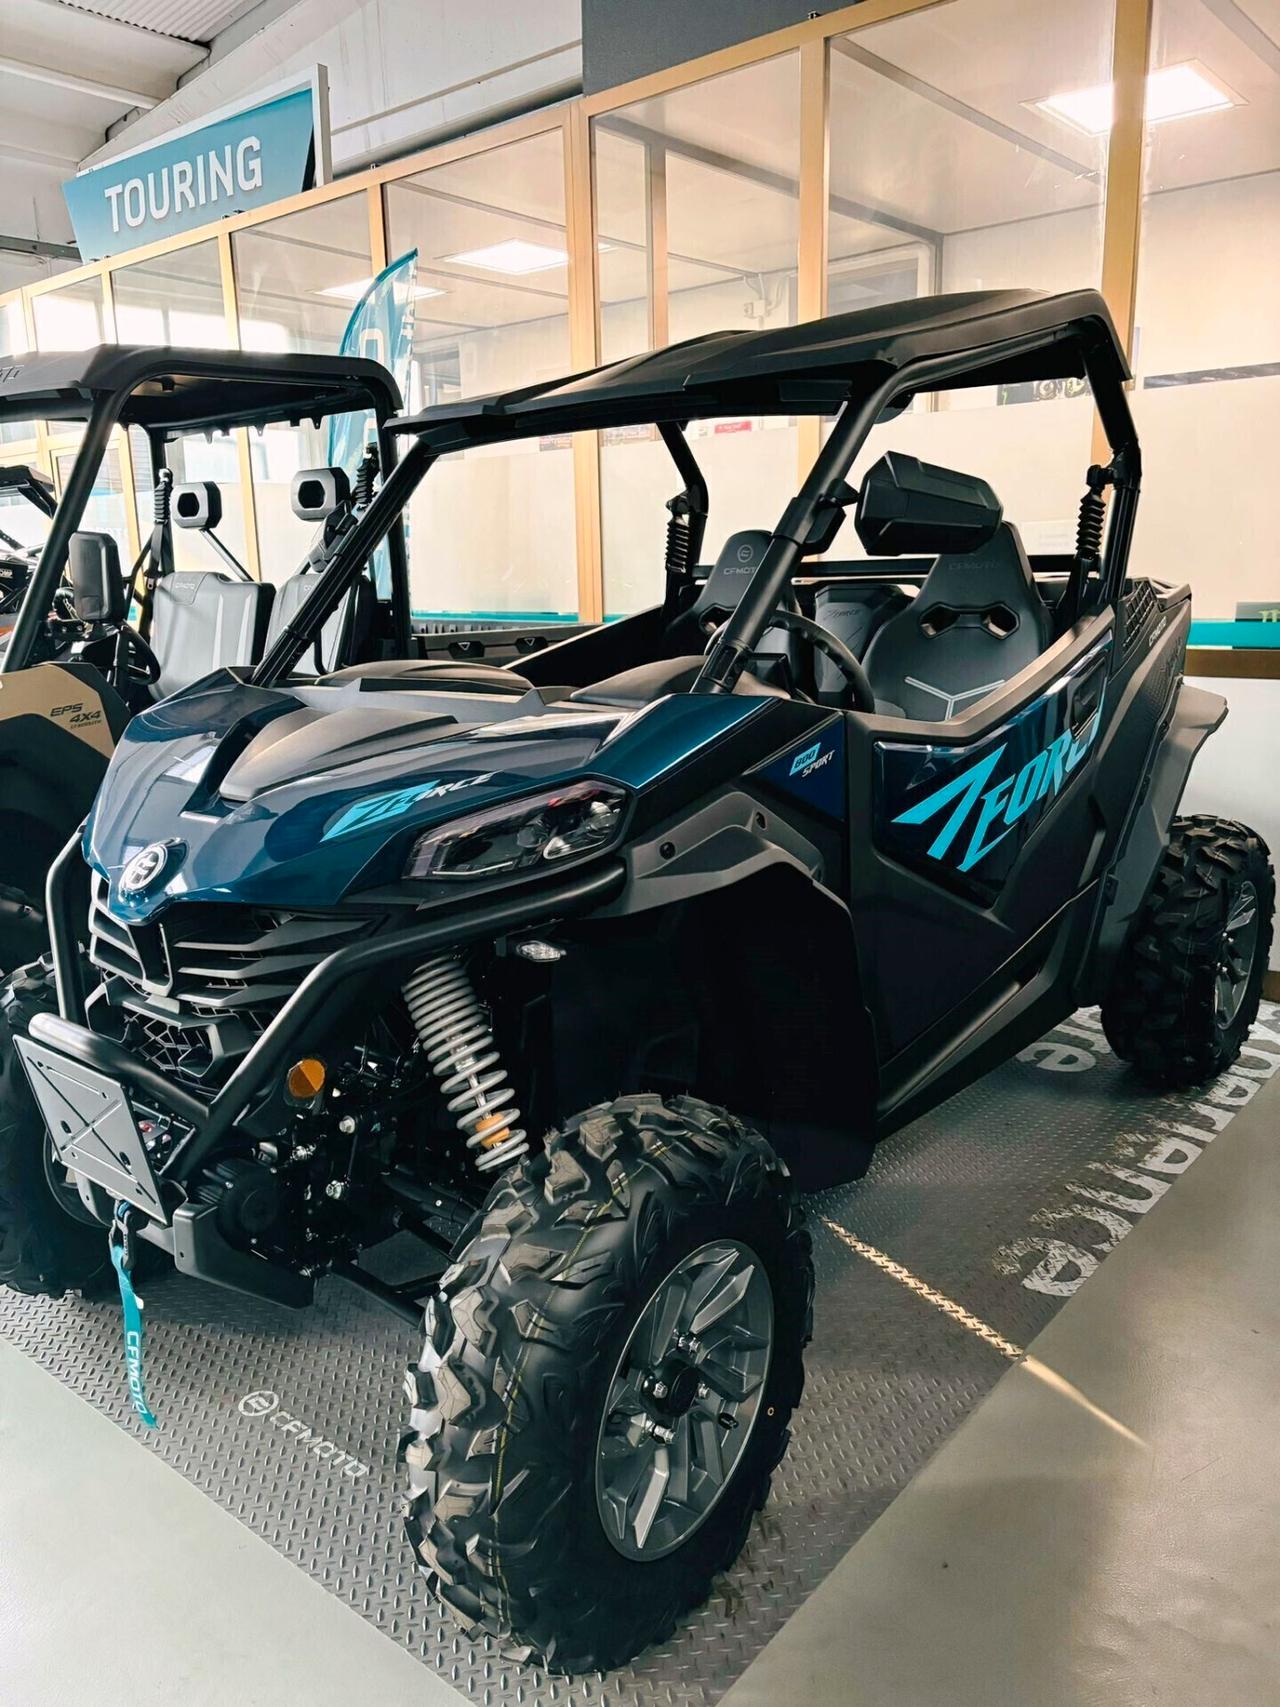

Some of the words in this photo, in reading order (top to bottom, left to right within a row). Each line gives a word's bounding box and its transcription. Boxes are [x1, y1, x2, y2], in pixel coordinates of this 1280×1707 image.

[104, 135, 264, 233] TOURING
[723, 566, 758, 576] CFMOT
[50, 702, 84, 717] EPS
[801, 749, 836, 778] SPORT
[126, 1330, 149, 1415] CFMOTO
[269, 1410, 369, 1478] CFMOTO
